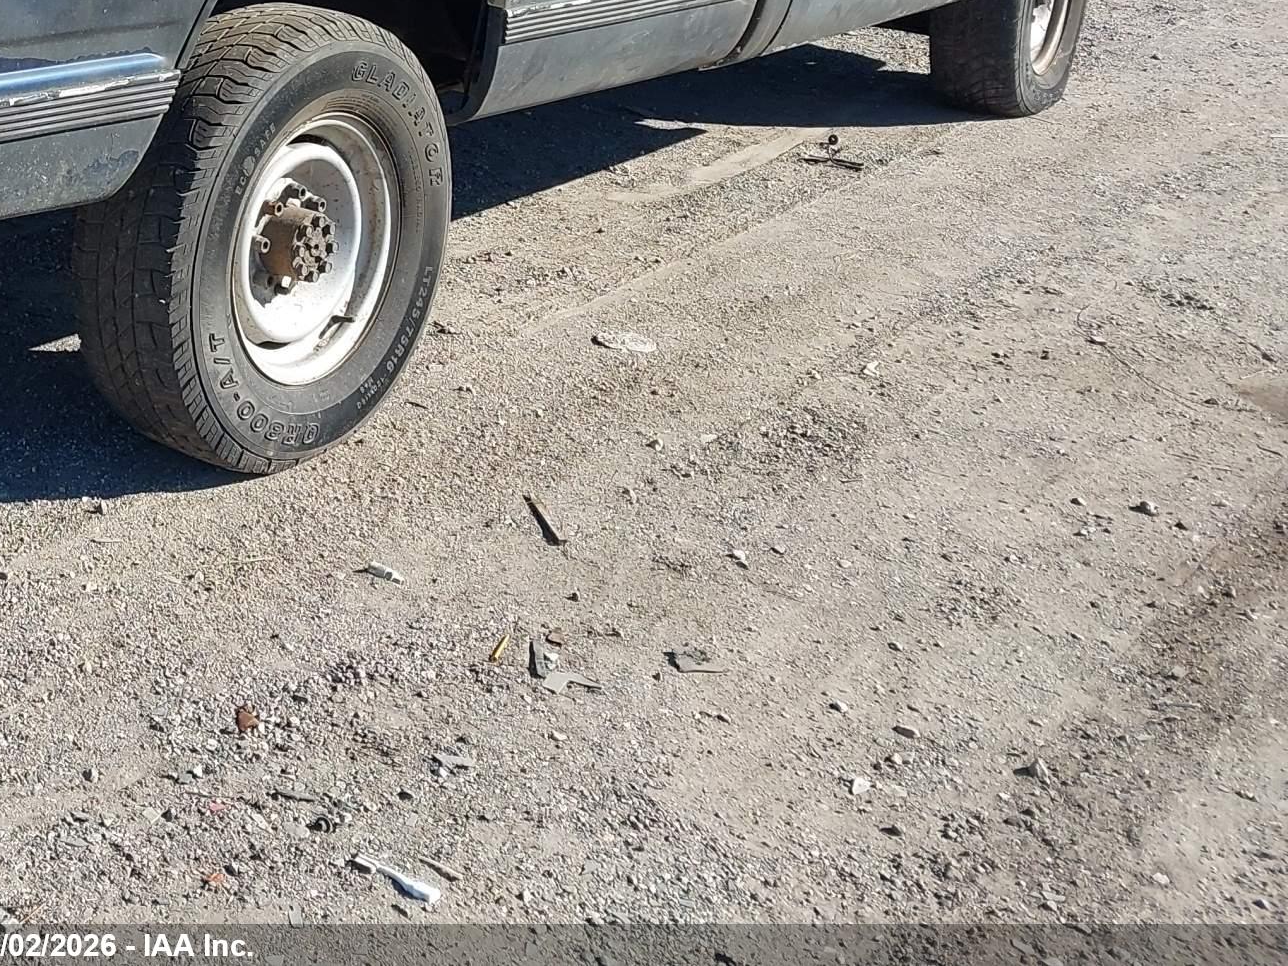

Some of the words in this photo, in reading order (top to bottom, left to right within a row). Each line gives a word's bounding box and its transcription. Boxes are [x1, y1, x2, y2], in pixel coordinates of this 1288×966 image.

[352, 61, 444, 187] GLADIATOR
[386, 265, 433, 374] LT245/75R16
[208, 333, 320, 445] QR800-A/T
